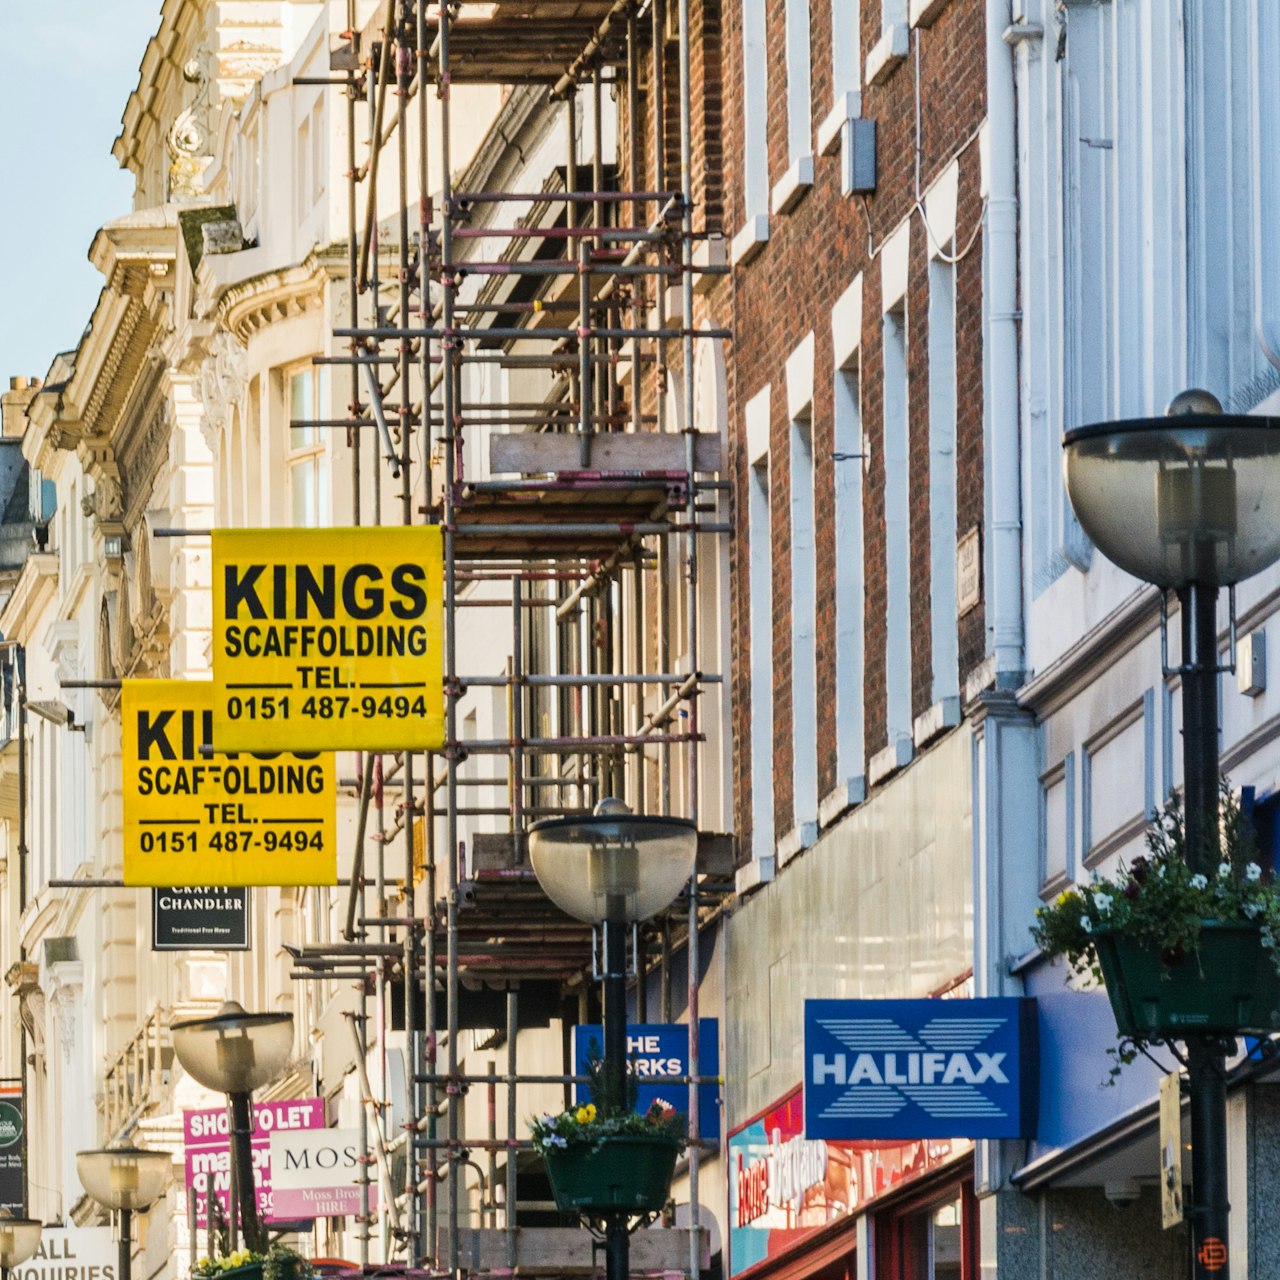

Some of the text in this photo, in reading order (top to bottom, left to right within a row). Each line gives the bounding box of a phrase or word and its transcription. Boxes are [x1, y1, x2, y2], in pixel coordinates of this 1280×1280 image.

[224, 563, 428, 621] KINGS
[224, 625, 428, 658] SCAFFOLDING
[296, 665, 357, 690] TEL.
[227, 695, 428, 721] 0151 487-9494
[203, 803, 259, 825] TEL.
[139, 830, 325, 853] 0151 487-9494
[159, 896, 243, 911] CHANDLER
[627, 1035, 661, 1054] HE
[812, 1052, 1011, 1086] HALIFAX
[190, 1112, 229, 1137] SHO
[276, 1105, 314, 1129] LET
[303, 1186, 360, 1201] Moss Bros
[315, 1200, 348, 1213] HIRE
[32, 1237, 77, 1260] ALL
